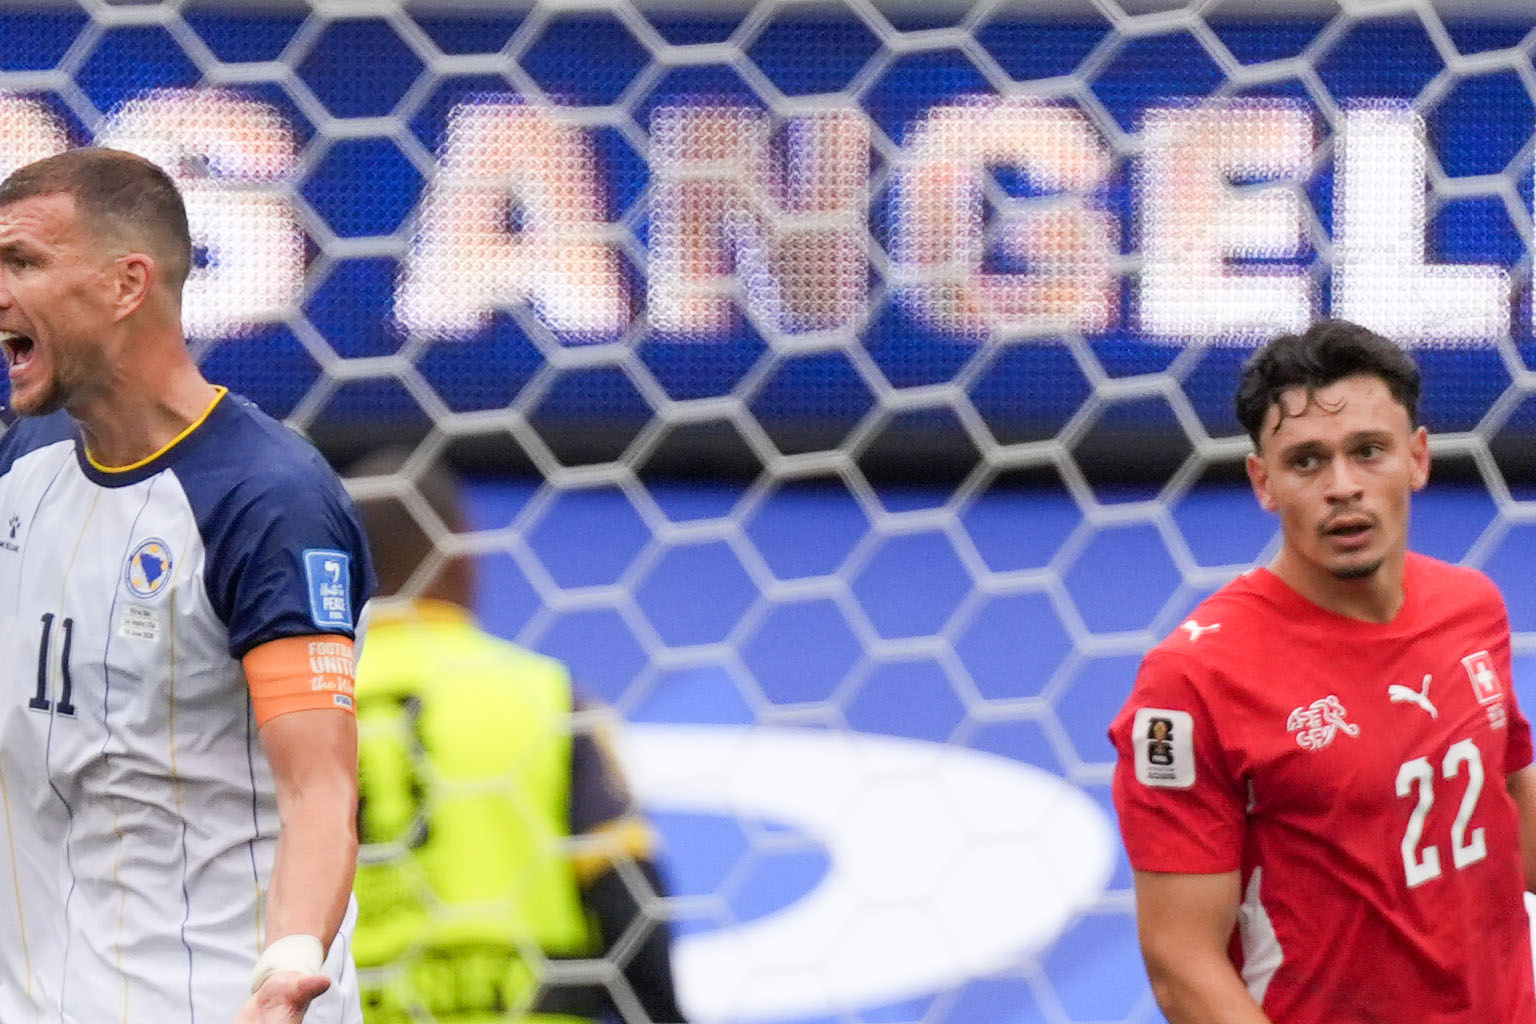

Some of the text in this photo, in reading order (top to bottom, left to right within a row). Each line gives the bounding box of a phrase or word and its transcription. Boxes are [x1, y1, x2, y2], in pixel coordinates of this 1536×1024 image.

[393, 90, 1536, 350] ANGEL
[29, 612, 77, 719] 11
[1395, 737, 1487, 888] 22
